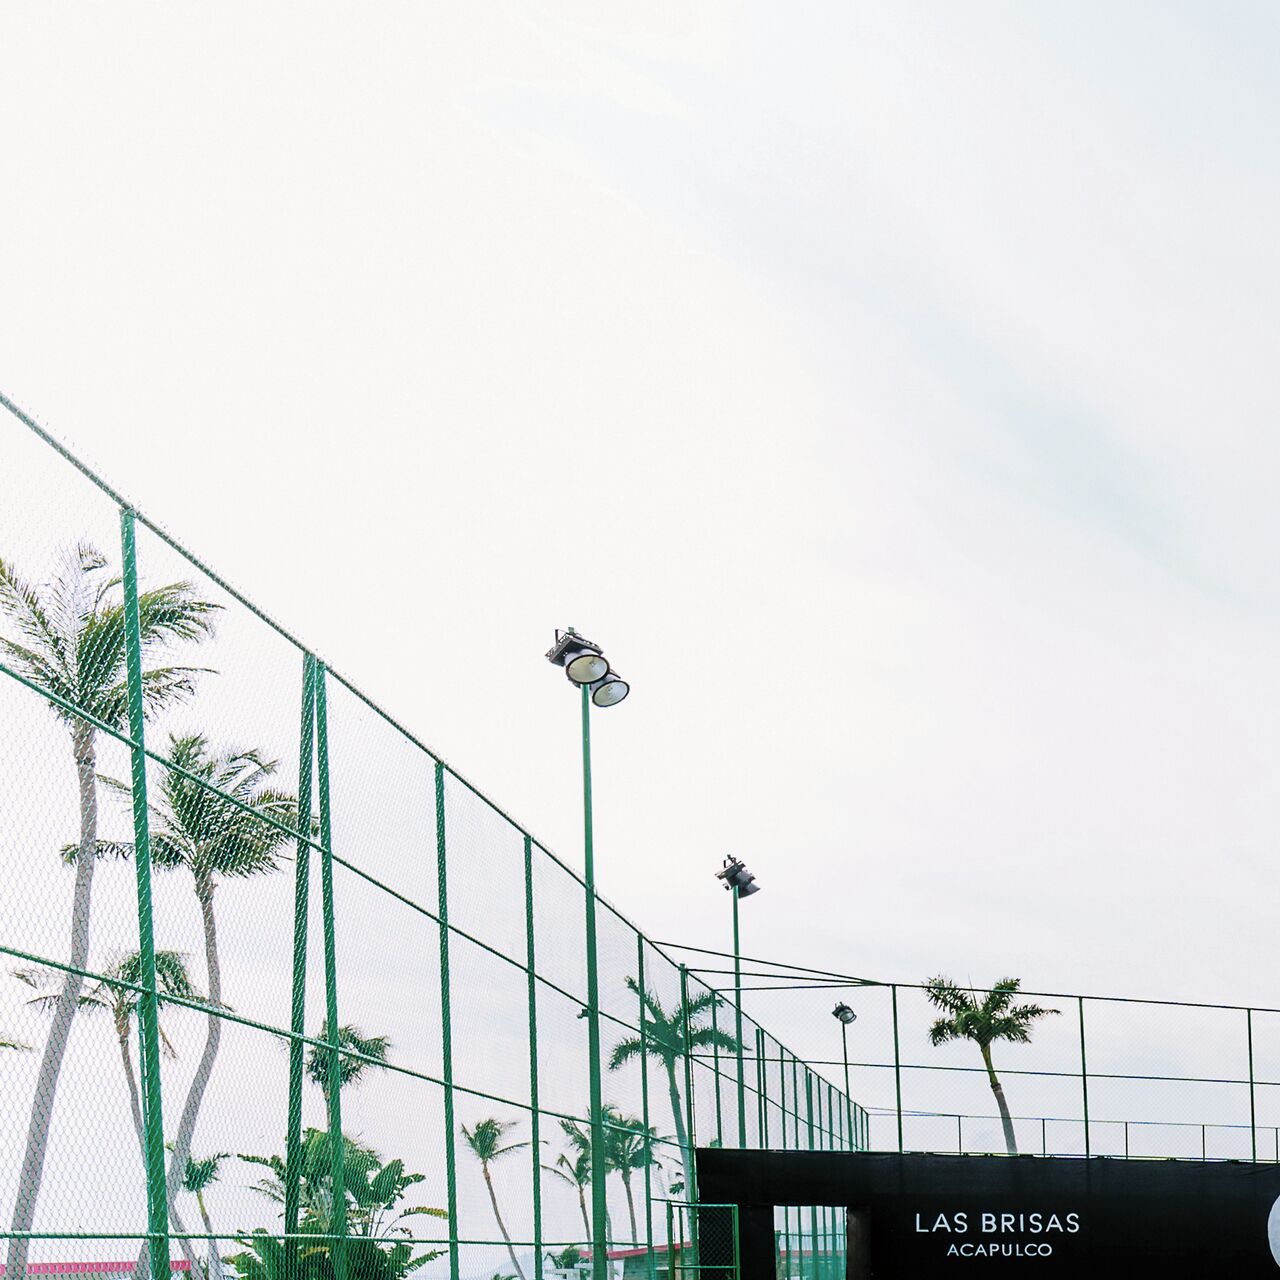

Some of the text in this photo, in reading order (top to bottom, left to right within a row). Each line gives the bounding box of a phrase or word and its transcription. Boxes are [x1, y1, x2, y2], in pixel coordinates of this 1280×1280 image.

[915, 1212, 1080, 1233] LAS BRISAS
[946, 1243, 1053, 1257] ACAPULCO
